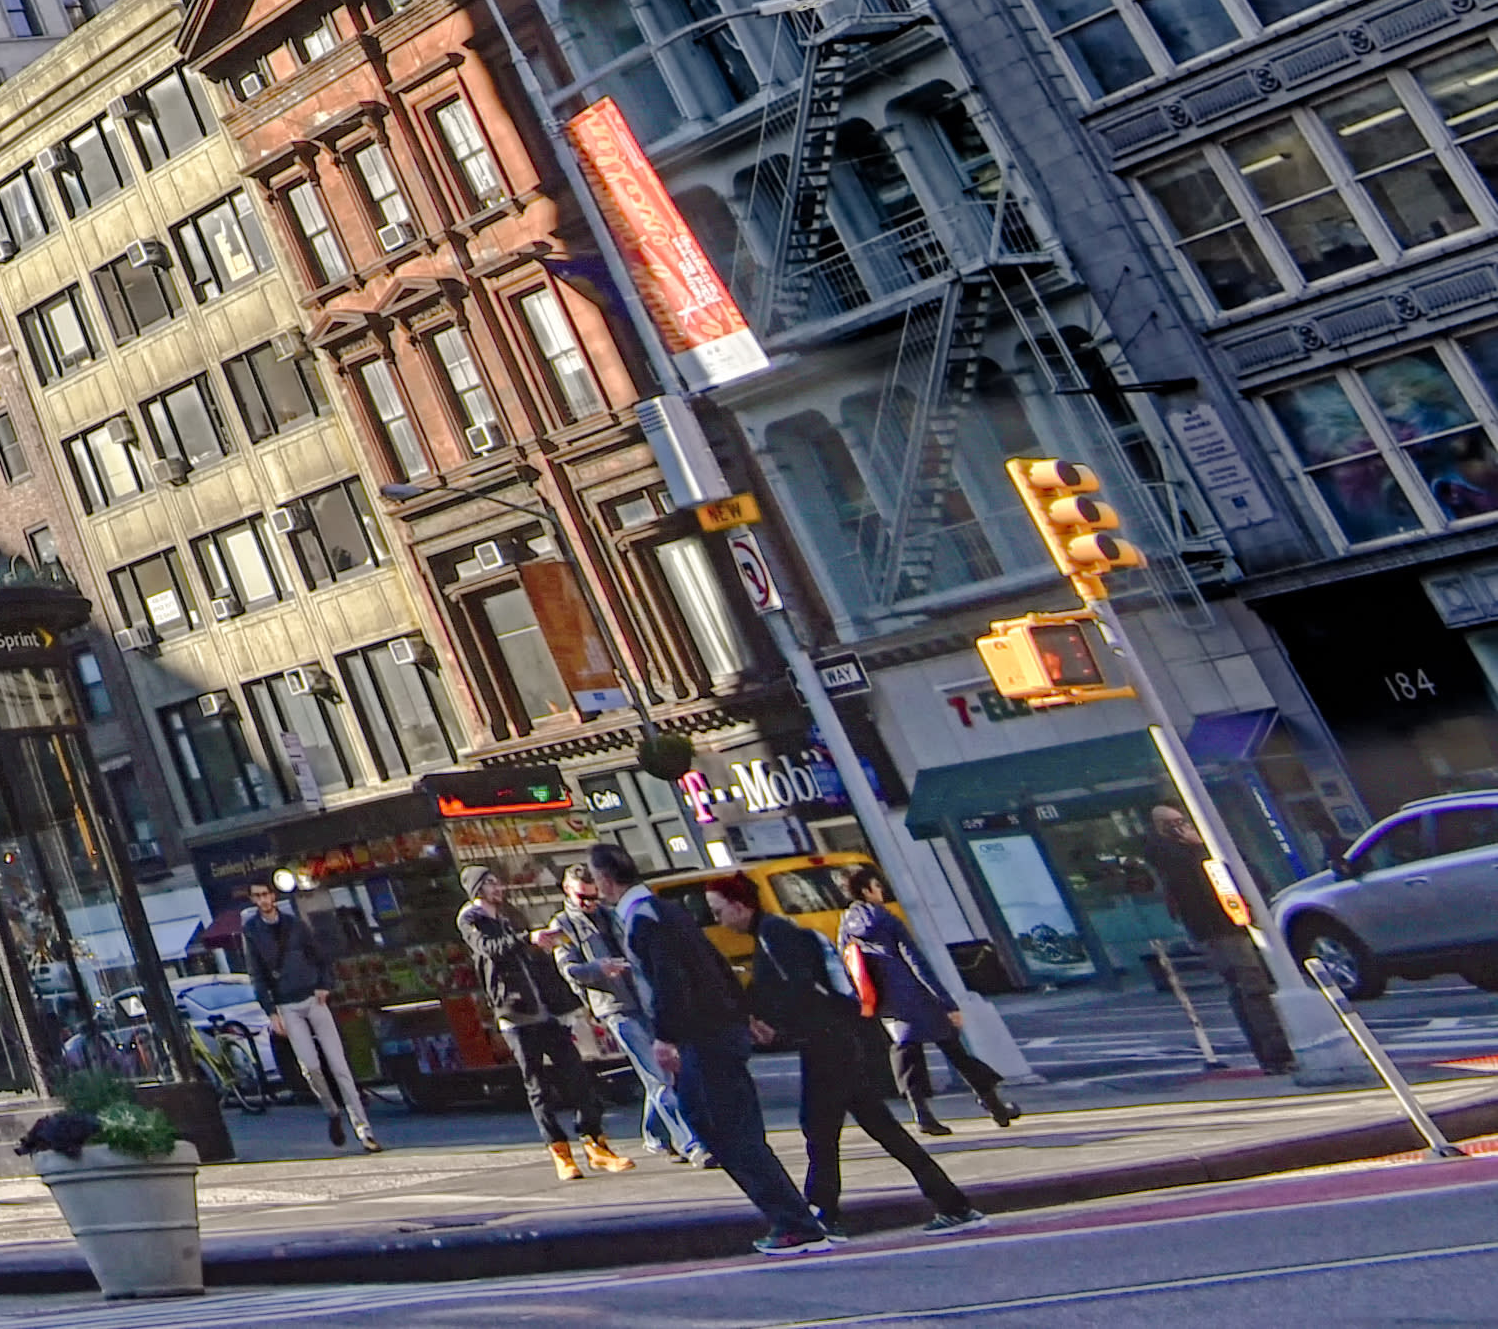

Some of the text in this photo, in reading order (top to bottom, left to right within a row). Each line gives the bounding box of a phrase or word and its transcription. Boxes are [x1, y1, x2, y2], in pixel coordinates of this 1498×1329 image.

[708, 502, 741, 523] NEW
[825, 667, 853, 684] WAY
[1384, 668, 1436, 701] 184
[593, 790, 622, 811] Cafe
